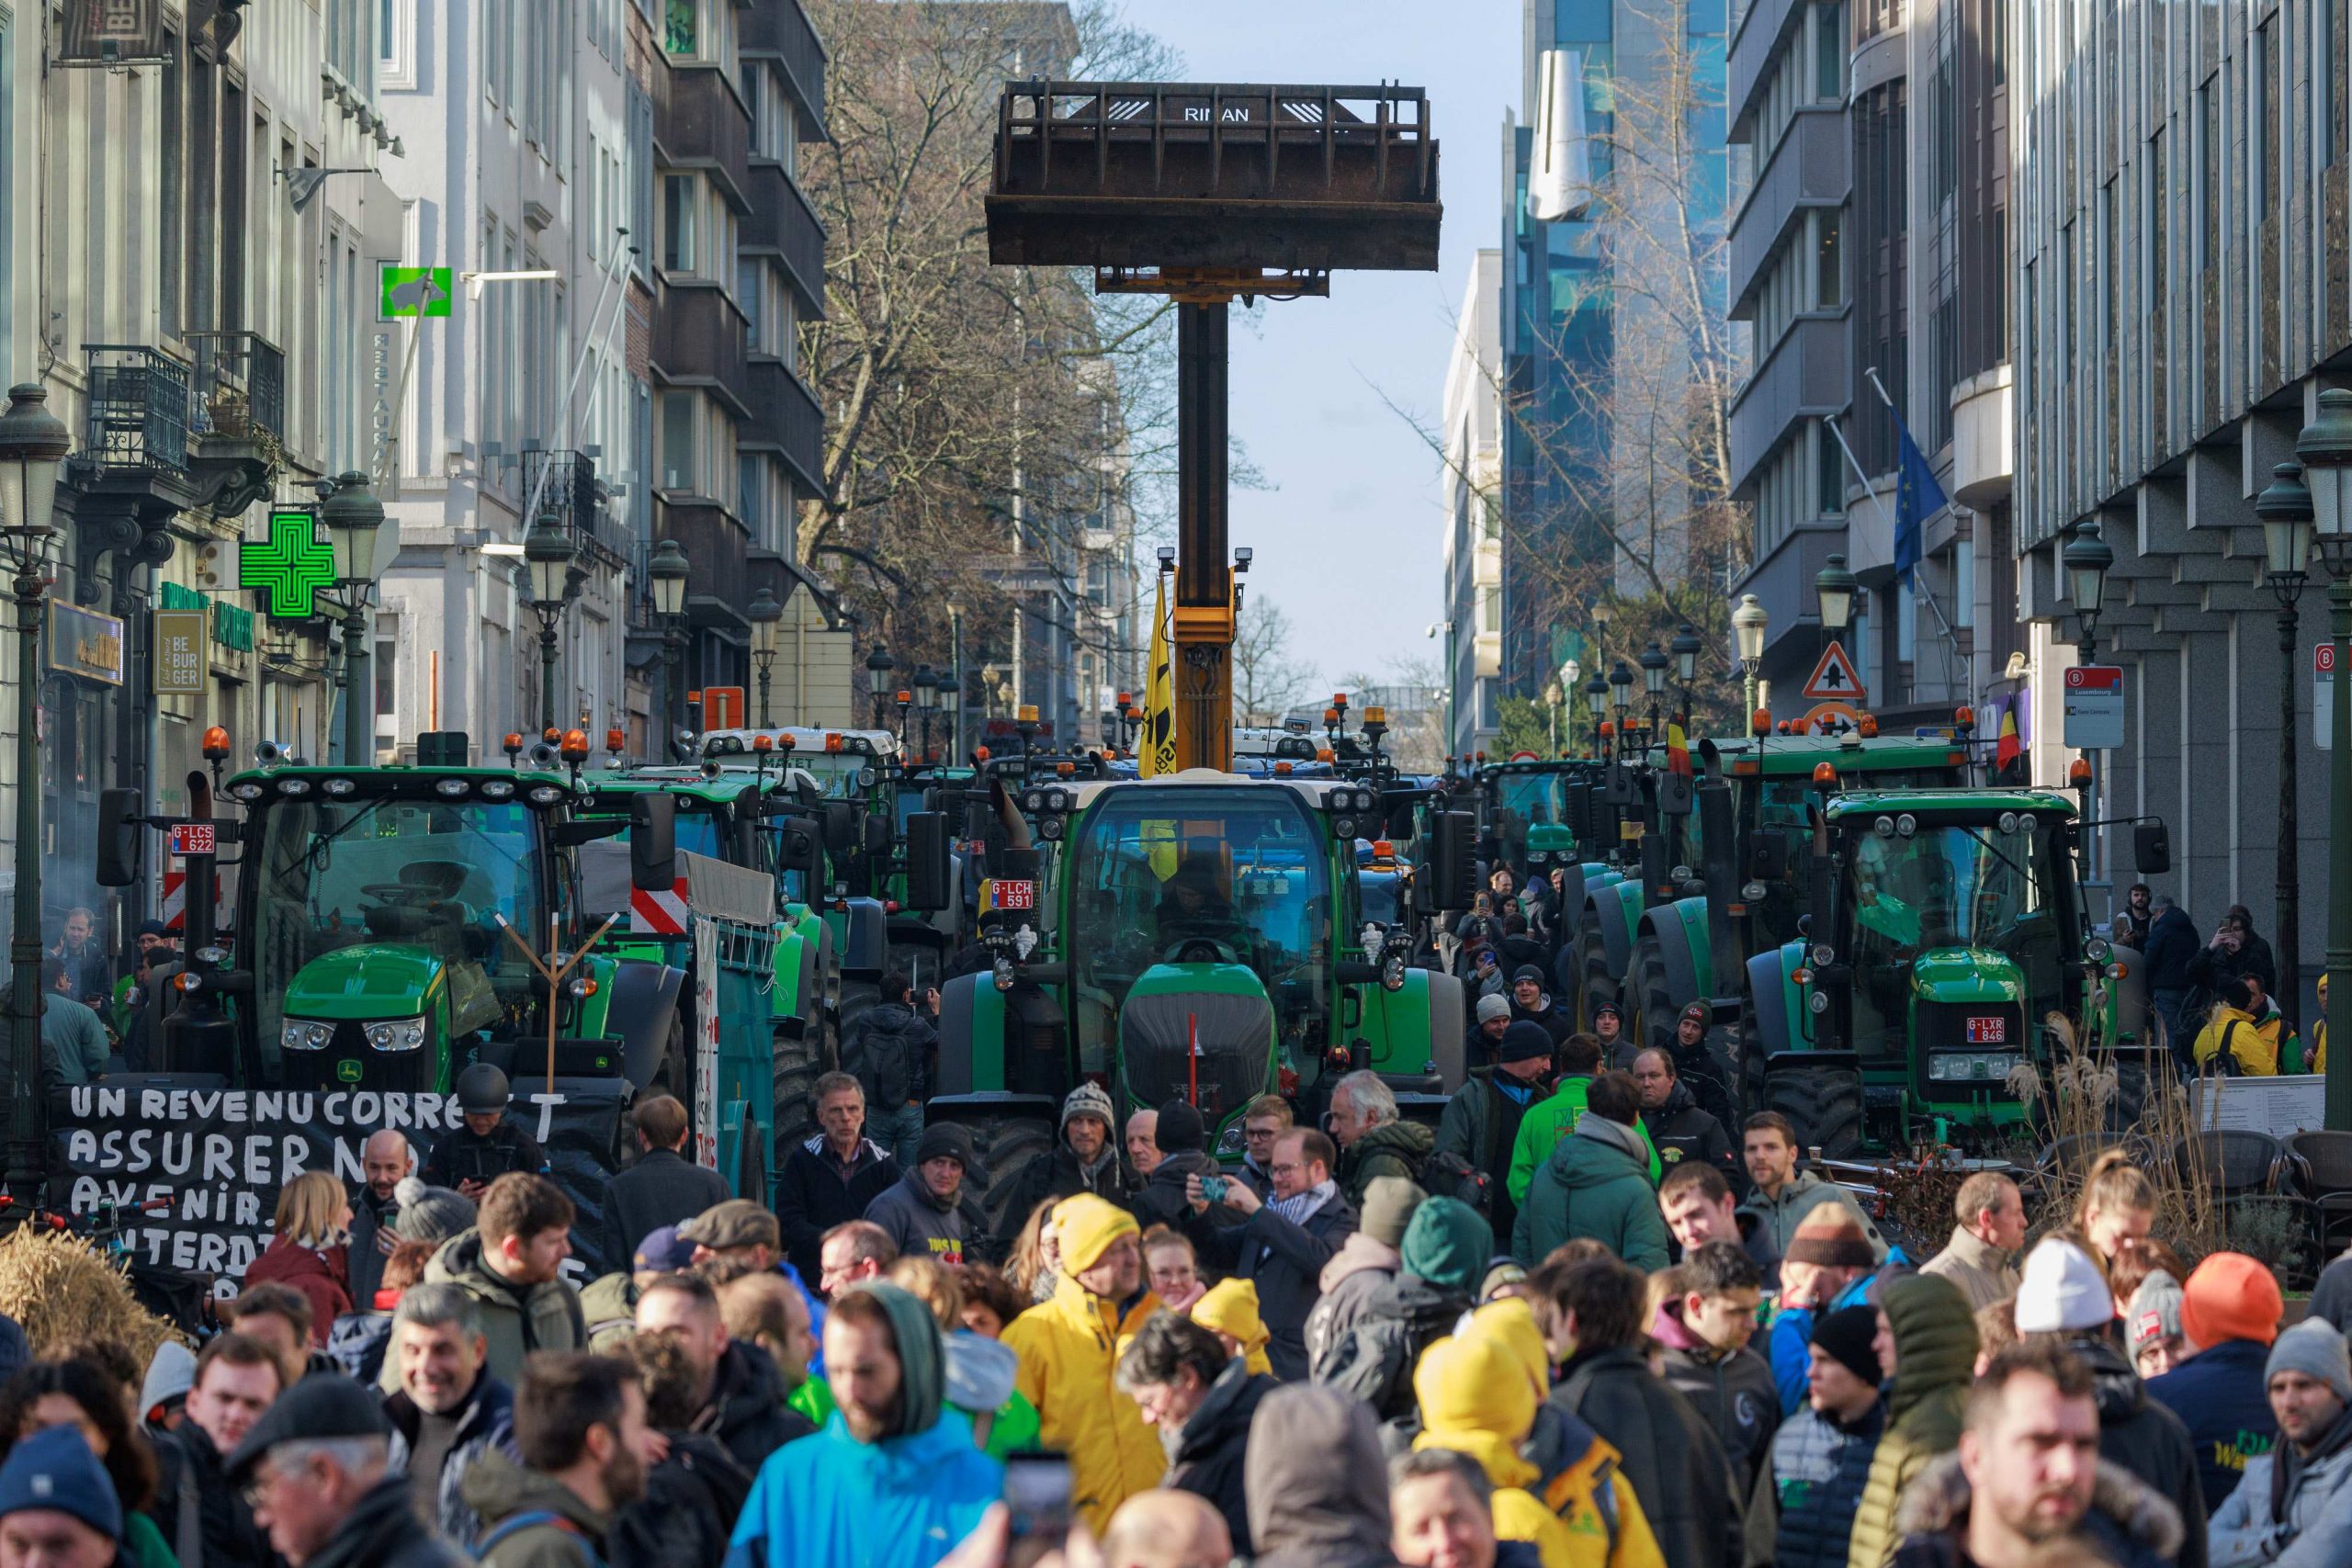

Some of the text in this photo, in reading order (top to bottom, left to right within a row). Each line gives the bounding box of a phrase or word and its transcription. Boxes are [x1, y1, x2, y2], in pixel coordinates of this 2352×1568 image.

[173, 637, 188, 651] BE
[173, 653, 198, 668] BUR
[2323, 653, 2330, 663] B
[173, 670, 198, 684] GER
[2073, 673, 2079, 682] B
[174, 827, 212, 838] G-LCS
[189, 840, 212, 851] 622
[992, 883, 1030, 894] G-LCH
[1007, 895, 1029, 907] 591
[1969, 1020, 2002, 1030] G-LXR
[1983, 1031, 2002, 1040] 846
[71, 1086, 125, 1118] UN
[141, 1089, 313, 1123] REVENU
[68, 1129, 310, 1187] ASSURER
